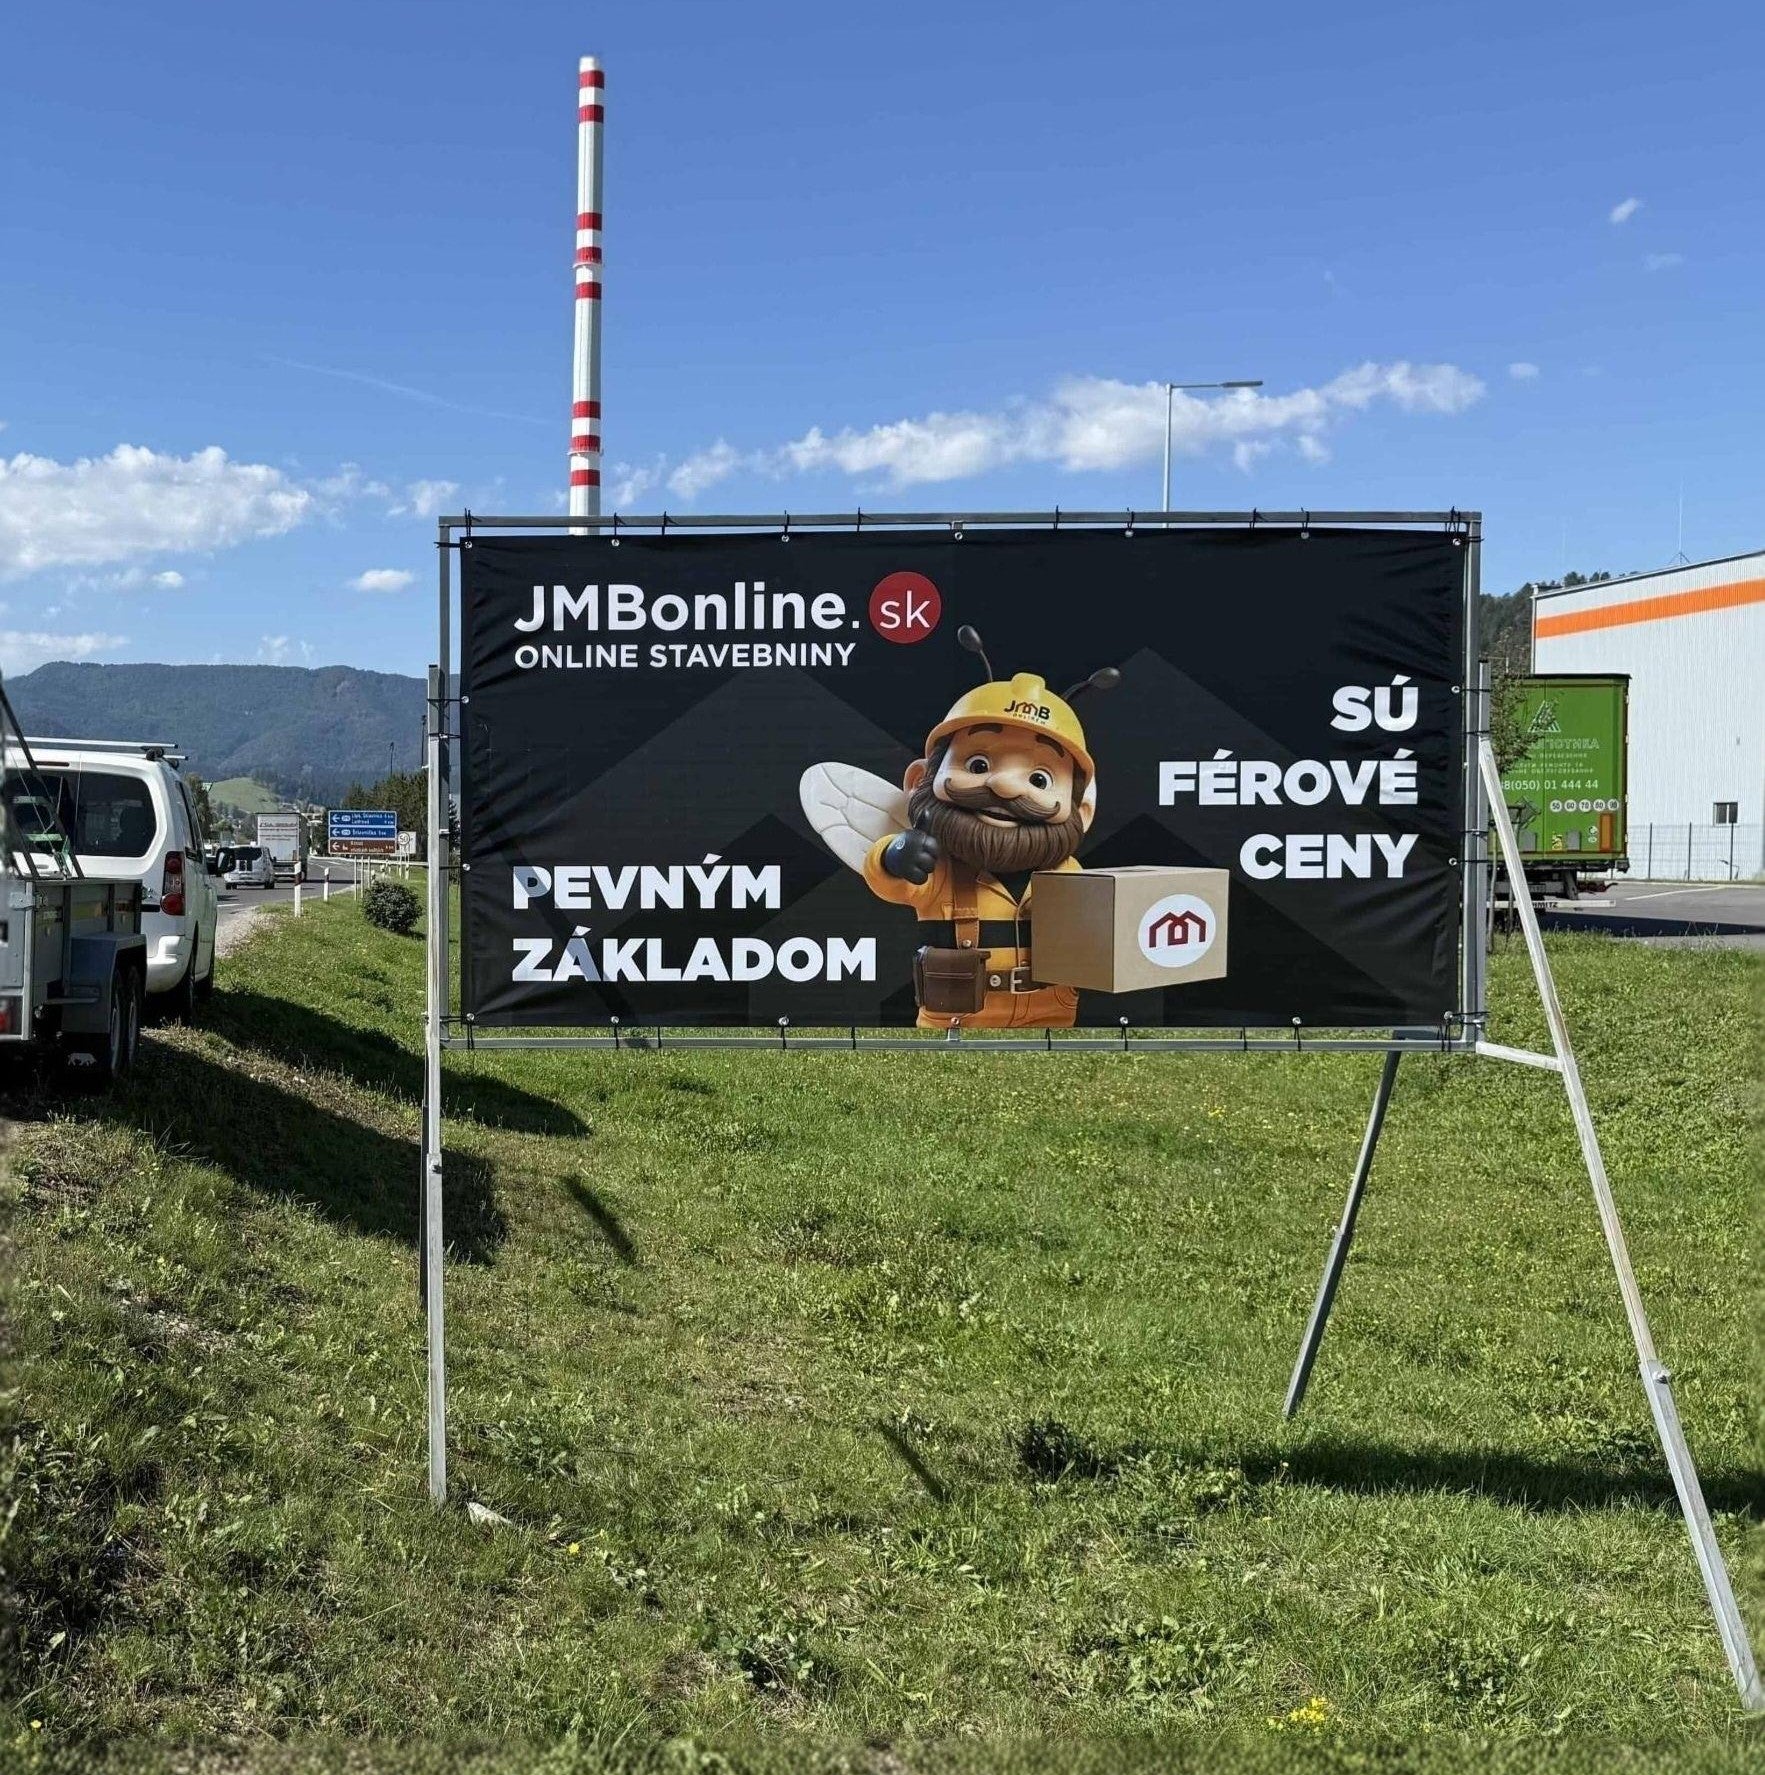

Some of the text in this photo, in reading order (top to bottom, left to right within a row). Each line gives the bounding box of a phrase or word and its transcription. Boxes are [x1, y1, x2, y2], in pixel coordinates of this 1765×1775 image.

[514, 642, 856, 669] ONLINE STAVEBNINY
[1331, 674, 1419, 732] SÚ
[1158, 748, 1419, 806] FÉROVÉ
[1544, 780, 1557, 790] 01
[1561, 779, 1582, 790] 444
[1585, 779, 1599, 789] 44
[399, 835, 409, 843] 50
[1239, 833, 1420, 880] CENY
[512, 853, 782, 910] PEVNÝM
[512, 925, 877, 983] ZÁKLADOM
